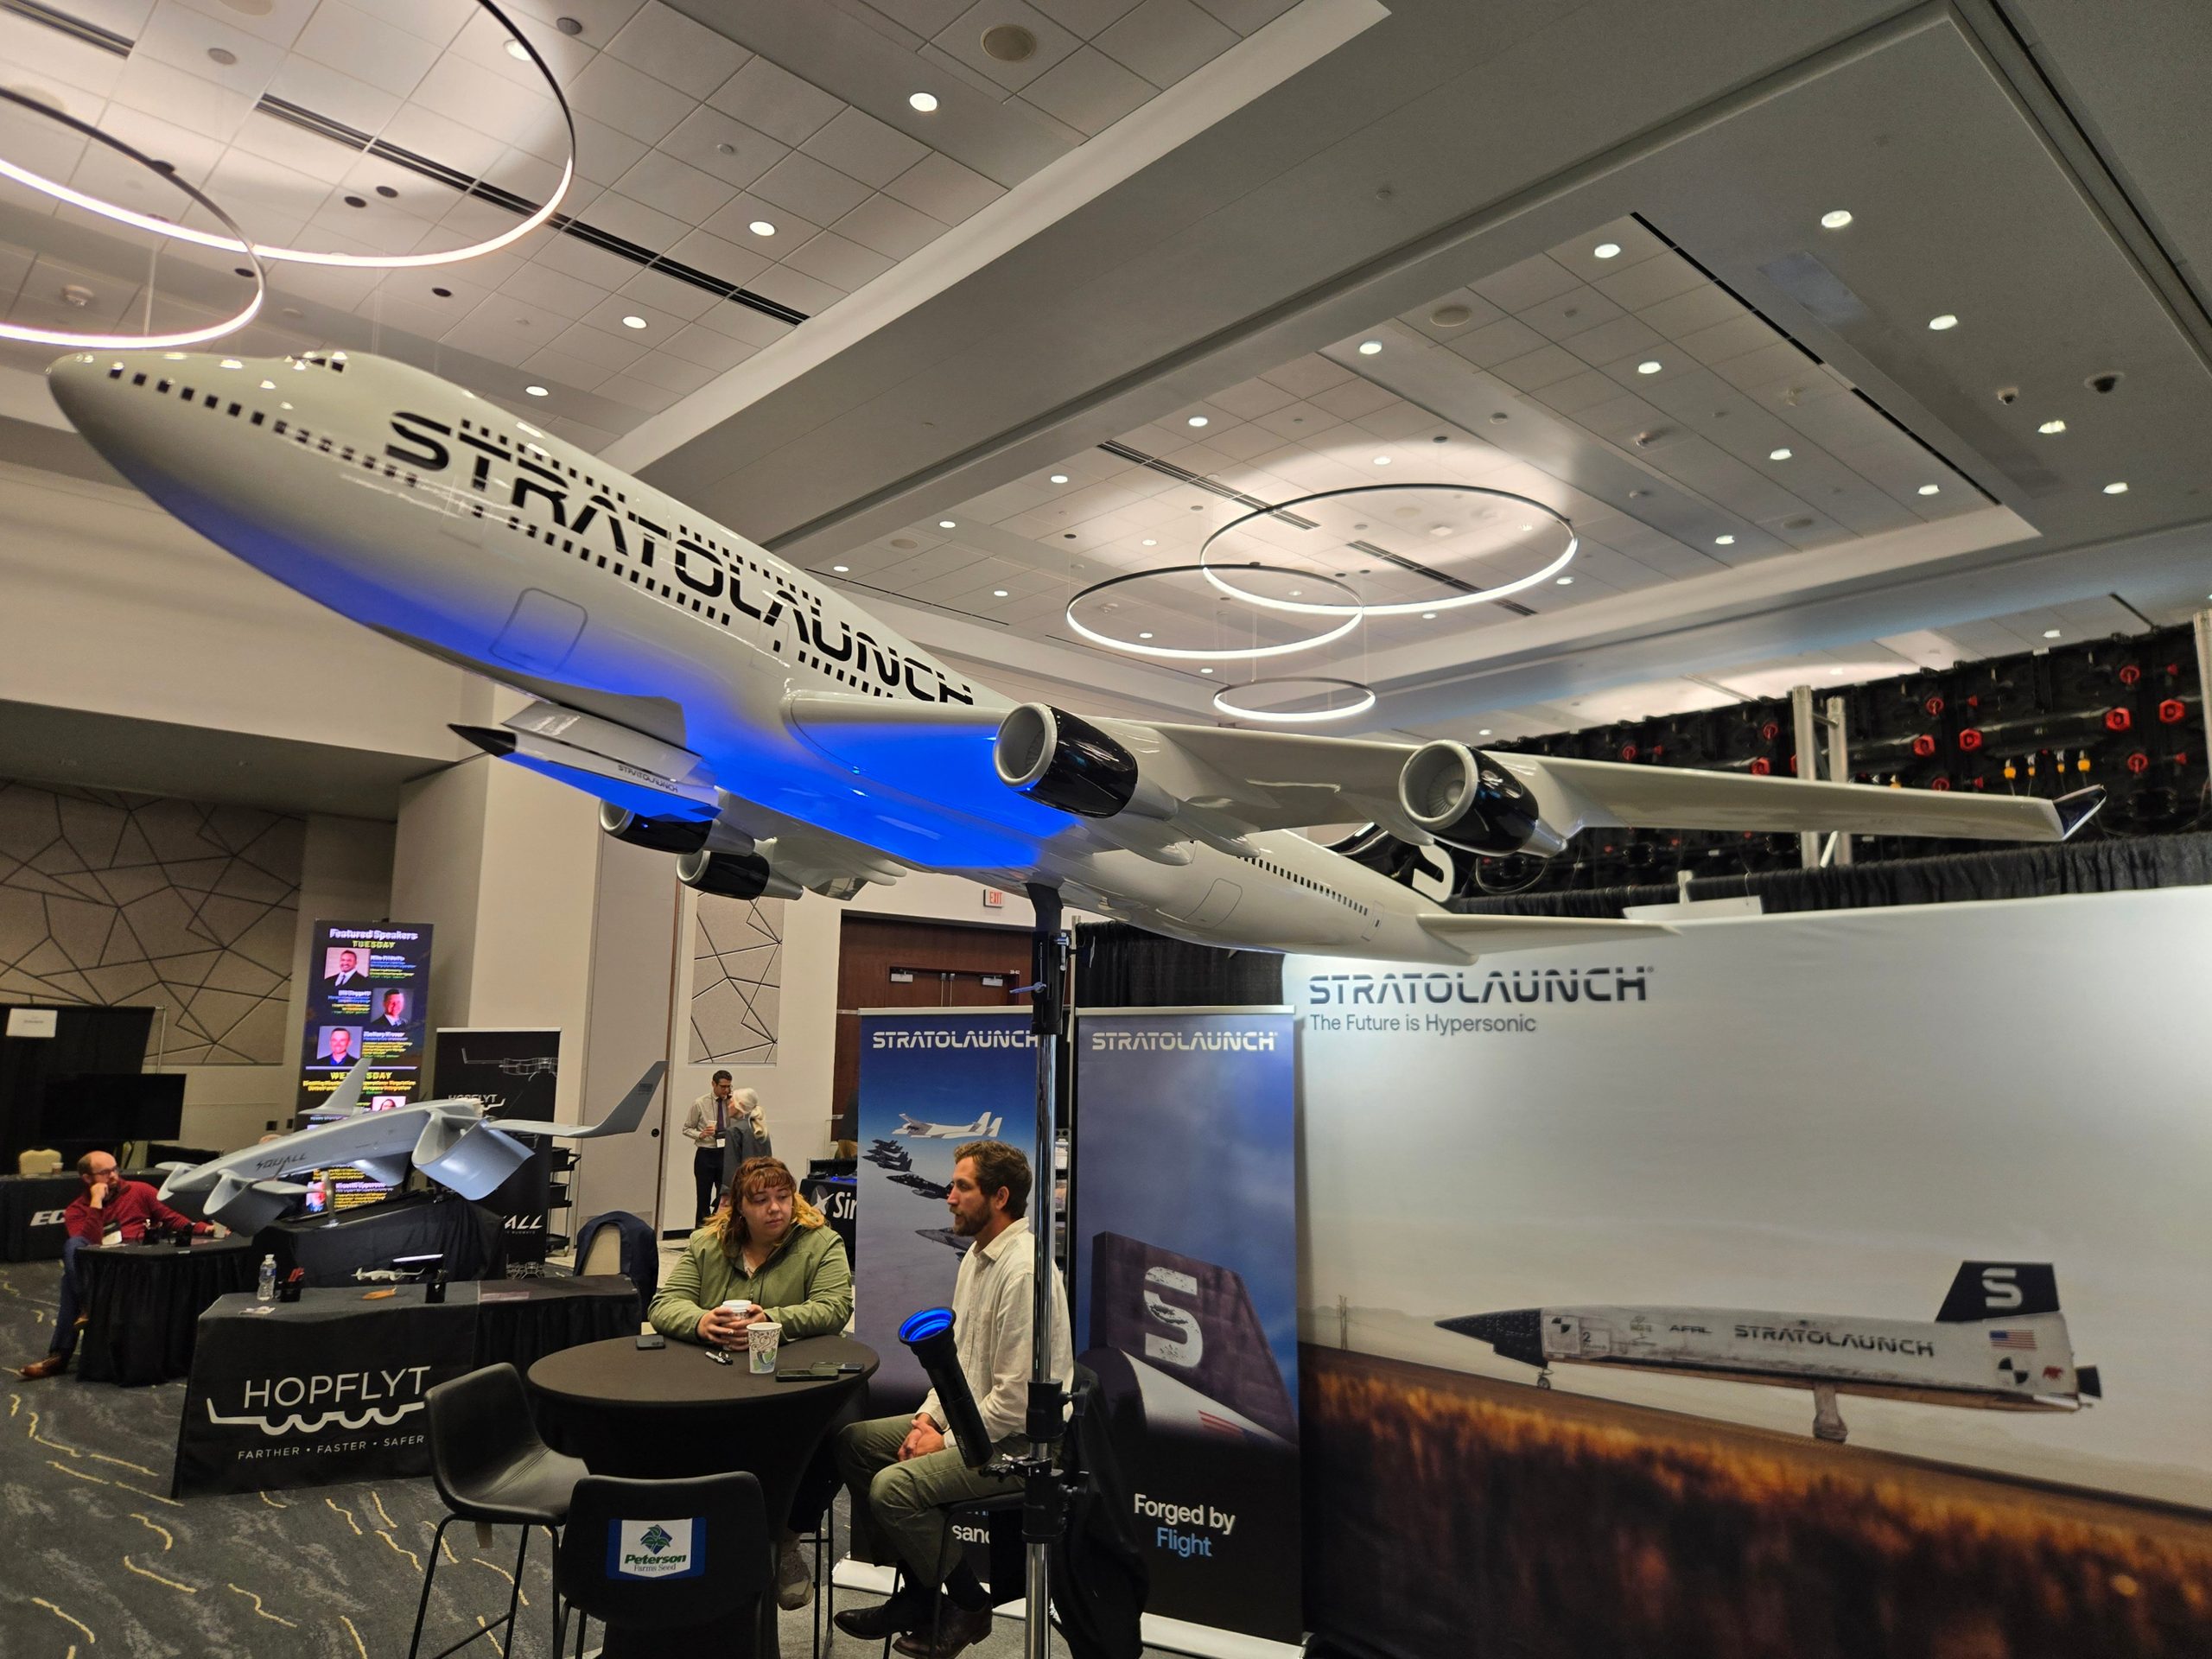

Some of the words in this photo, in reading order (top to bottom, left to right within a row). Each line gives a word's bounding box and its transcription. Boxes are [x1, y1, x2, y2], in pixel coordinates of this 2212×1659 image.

[385, 411, 974, 706] STRATOLAUNCH
[618, 764, 678, 793] STRATOLAUNCH
[989, 892, 1003, 905] EXIT
[329, 928, 373, 939] Featured
[374, 930, 419, 940] Speakers
[352, 940, 396, 949] TUESDAY
[1309, 966, 1647, 1005] STRATOLAUNCH
[1310, 1014, 1341, 1031] The
[1346, 1013, 1400, 1031] Future
[1406, 1014, 1420, 1031] is
[1426, 1014, 1537, 1036] Hypersonic
[872, 1030, 1038, 1049] STRATOLAUNCH
[1091, 1031, 1275, 1051] STRATOLAUNCH
[330, 1071, 392, 1080] WESDAY
[503, 1214, 543, 1230] ALL
[1734, 1324, 1935, 1357] STRATOLAUNCH
[244, 1365, 431, 1408] HOPFLYT
[238, 1446, 300, 1460] FARTHER
[317, 1441, 366, 1454] FASTER
[384, 1434, 425, 1447] SAFER
[1134, 1492, 1205, 1526] Forged
[1209, 1506, 1236, 1535] by
[1156, 1526, 1213, 1558] Flight
[624, 1554, 687, 1565] Peterson
[633, 1564, 657, 1573] Farms
